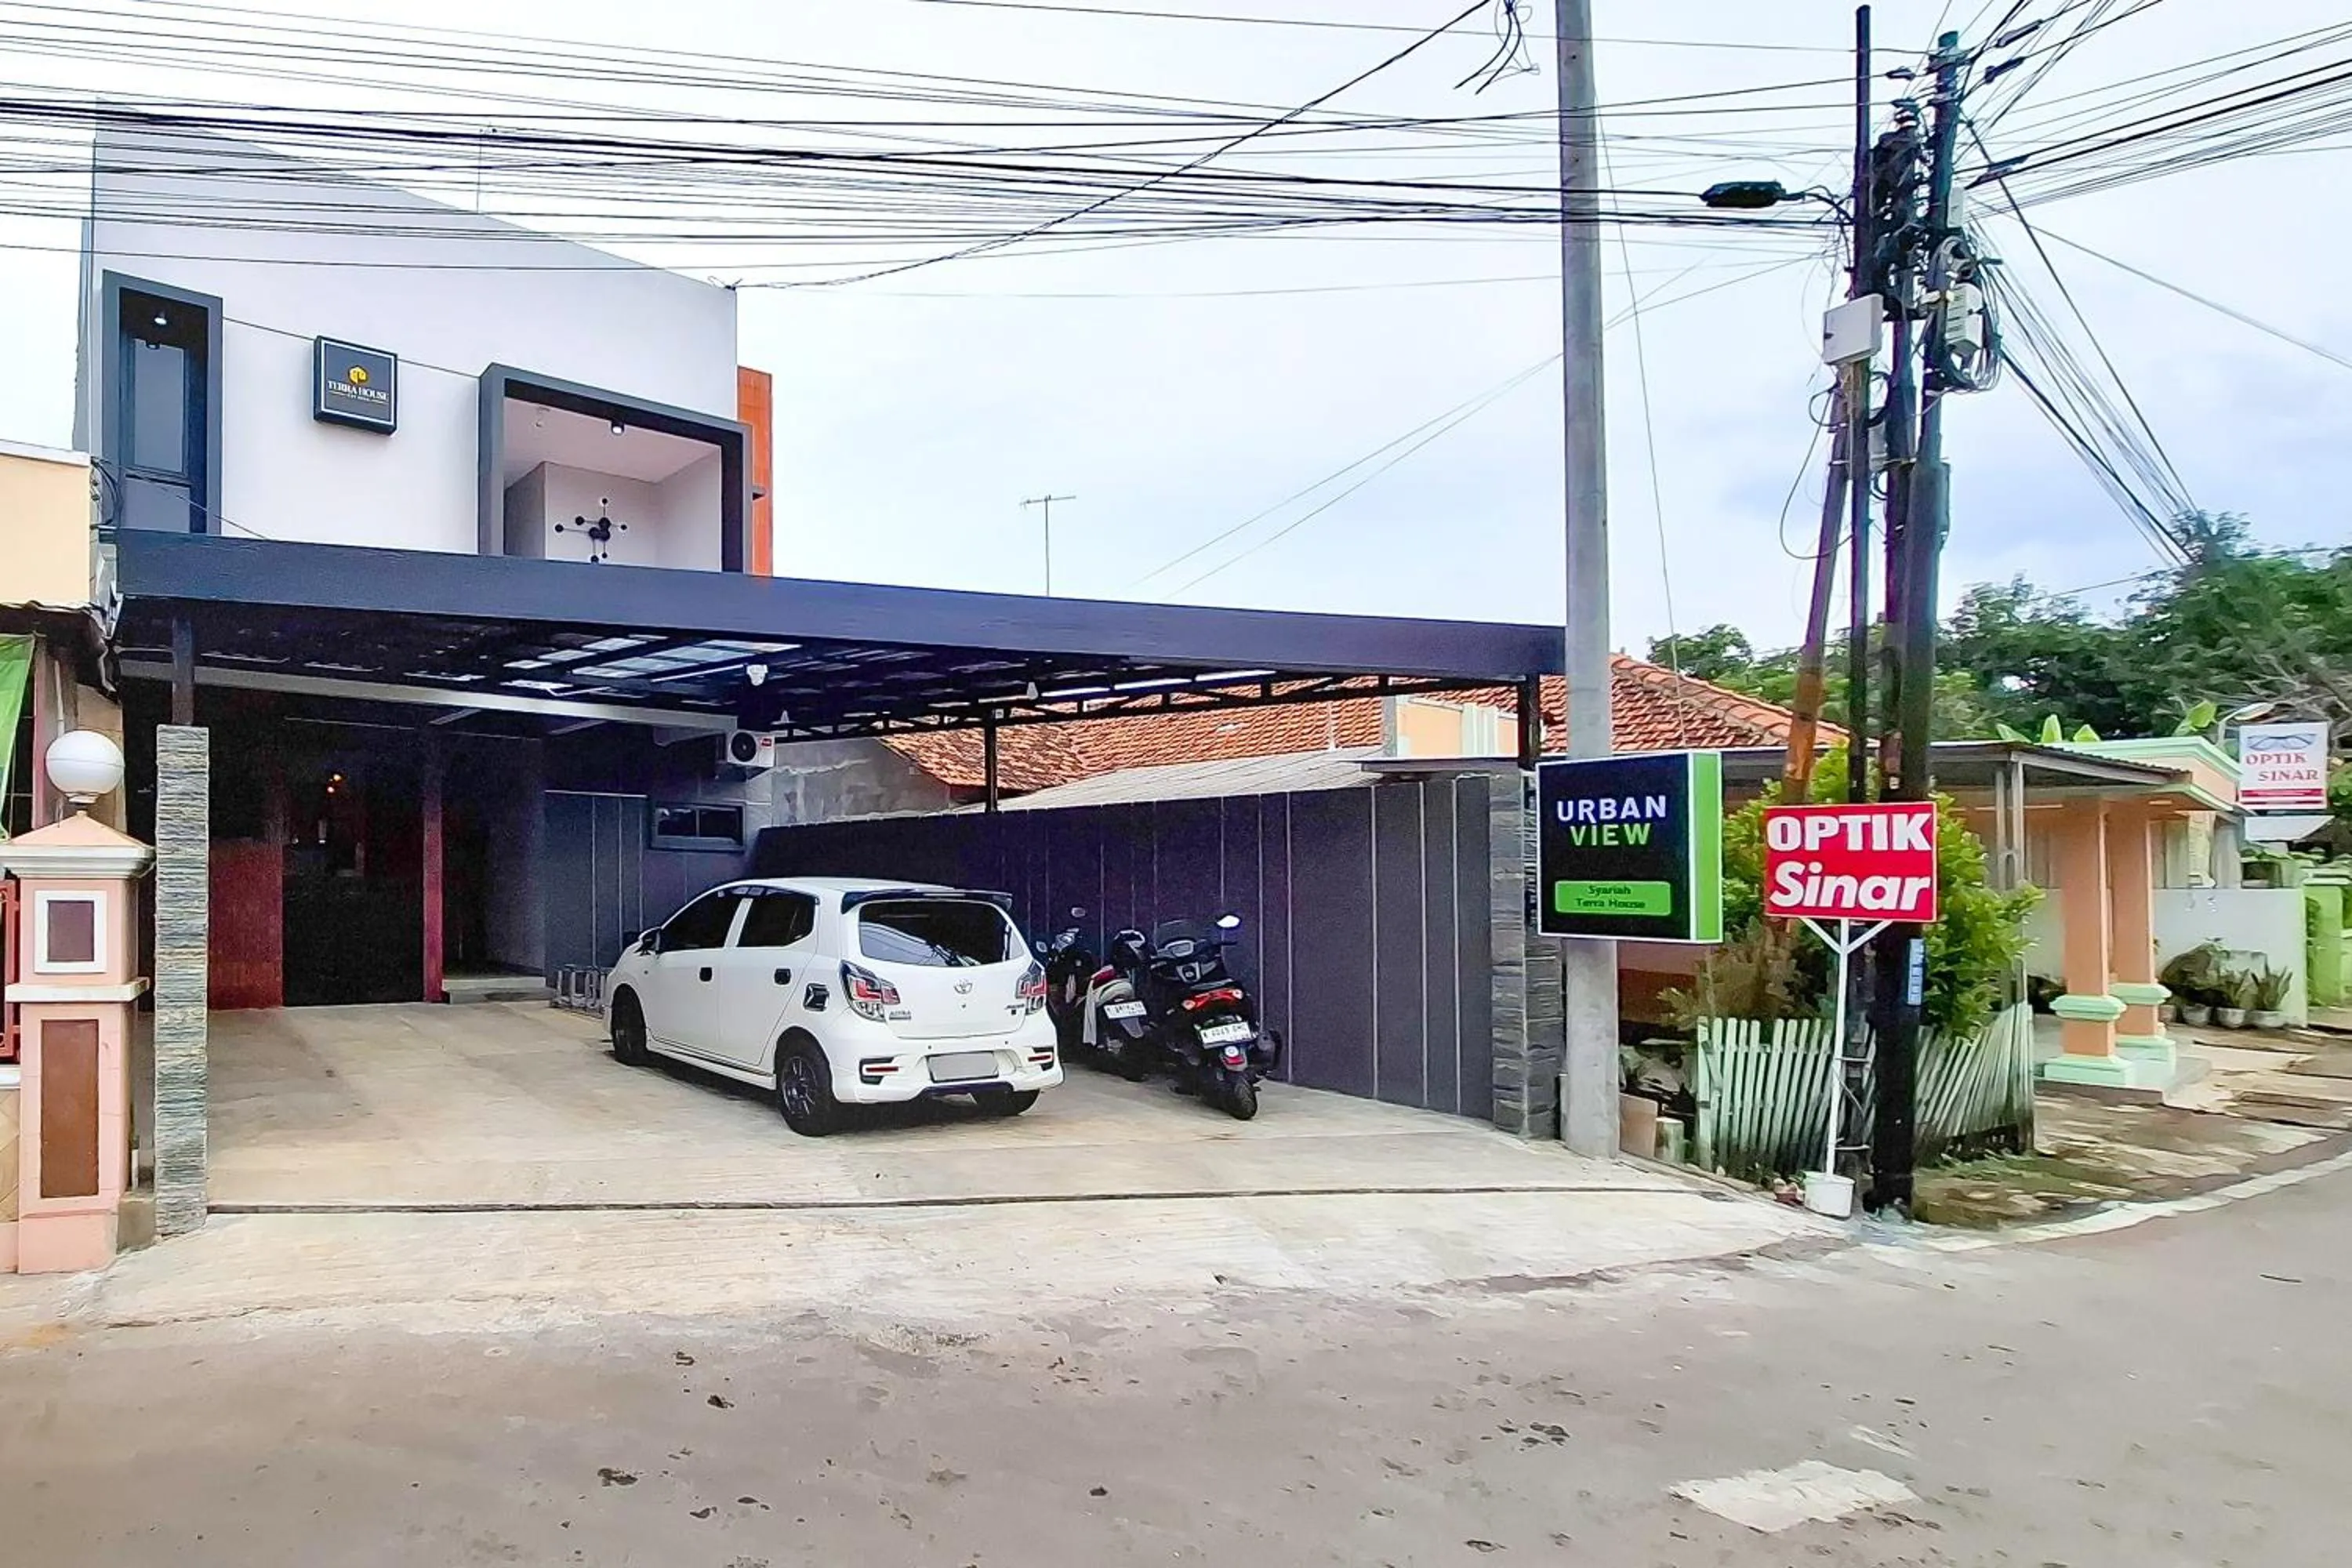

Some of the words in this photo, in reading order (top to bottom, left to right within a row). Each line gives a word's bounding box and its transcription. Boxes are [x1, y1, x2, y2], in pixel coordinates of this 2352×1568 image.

[358, 387, 387, 401] HOUSE
[2245, 752, 2307, 765] OPTIK
[2258, 769, 2319, 782] SINAR
[1557, 795, 1666, 823] URBAN
[1570, 823, 1650, 846] VIEW
[1767, 813, 1932, 851] OPTIK
[1588, 884, 1632, 896] Syariah
[1769, 861, 1931, 910] Sinar
[1576, 898, 1605, 908] Terra
[1608, 898, 1646, 909] House
